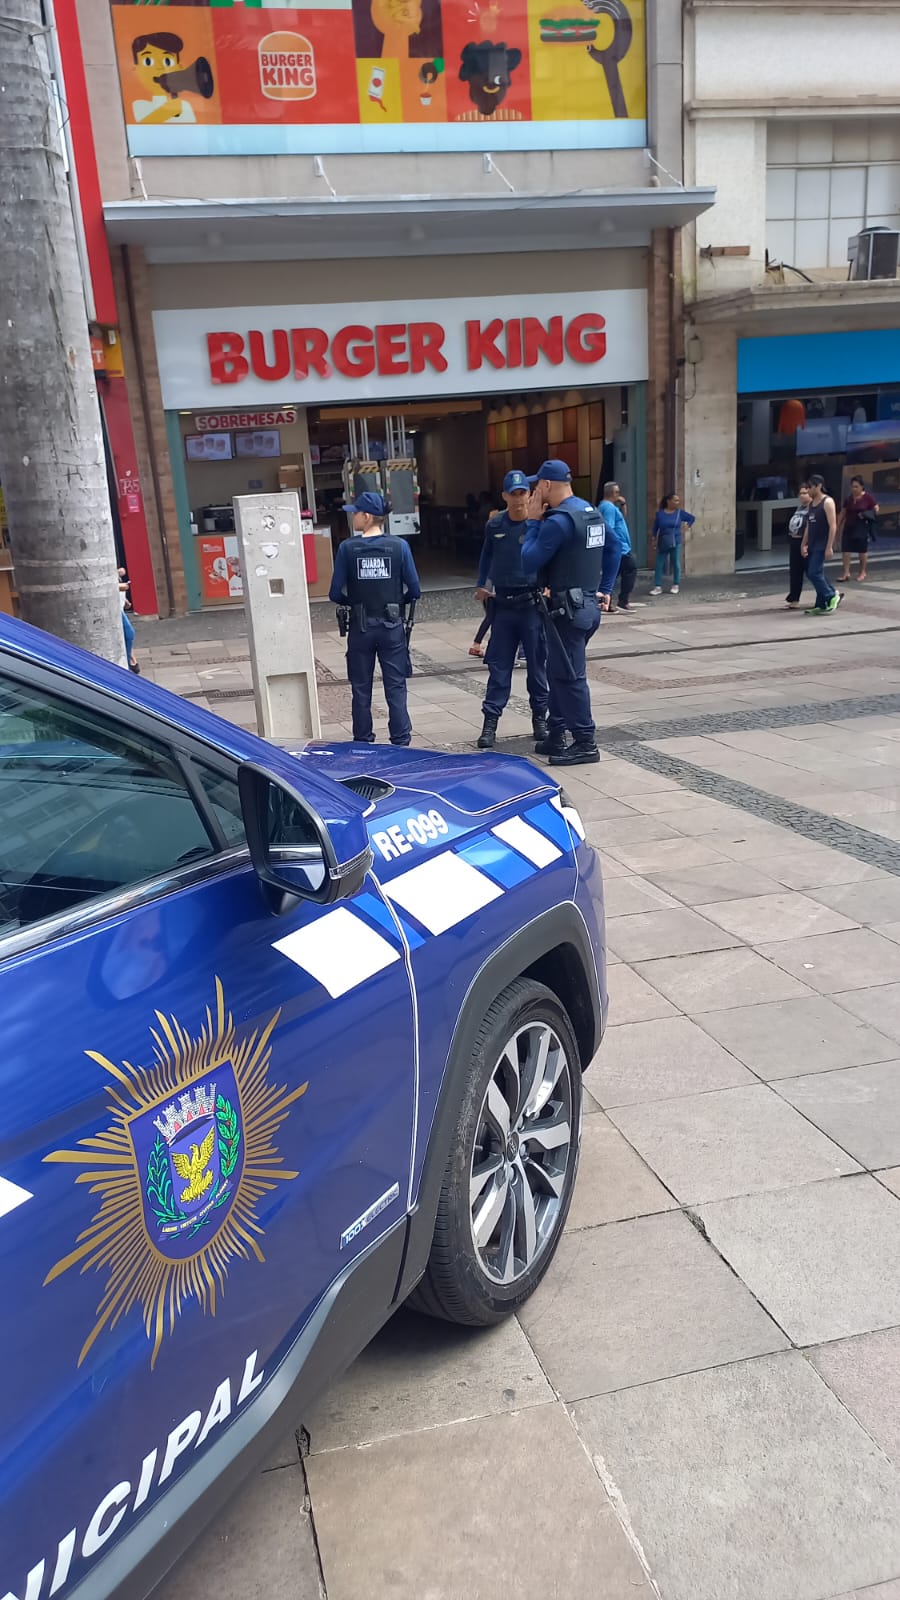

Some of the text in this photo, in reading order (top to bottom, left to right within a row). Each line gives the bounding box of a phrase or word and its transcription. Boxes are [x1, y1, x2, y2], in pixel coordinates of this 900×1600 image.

[261, 53, 312, 67] BURGER
[262, 67, 314, 86] KING
[206, 312, 608, 385] BURGER KING
[198, 411, 295, 430] SOBREMESAS
[361, 558, 385, 569] GUARDA
[371, 809, 449, 862] RE-099
